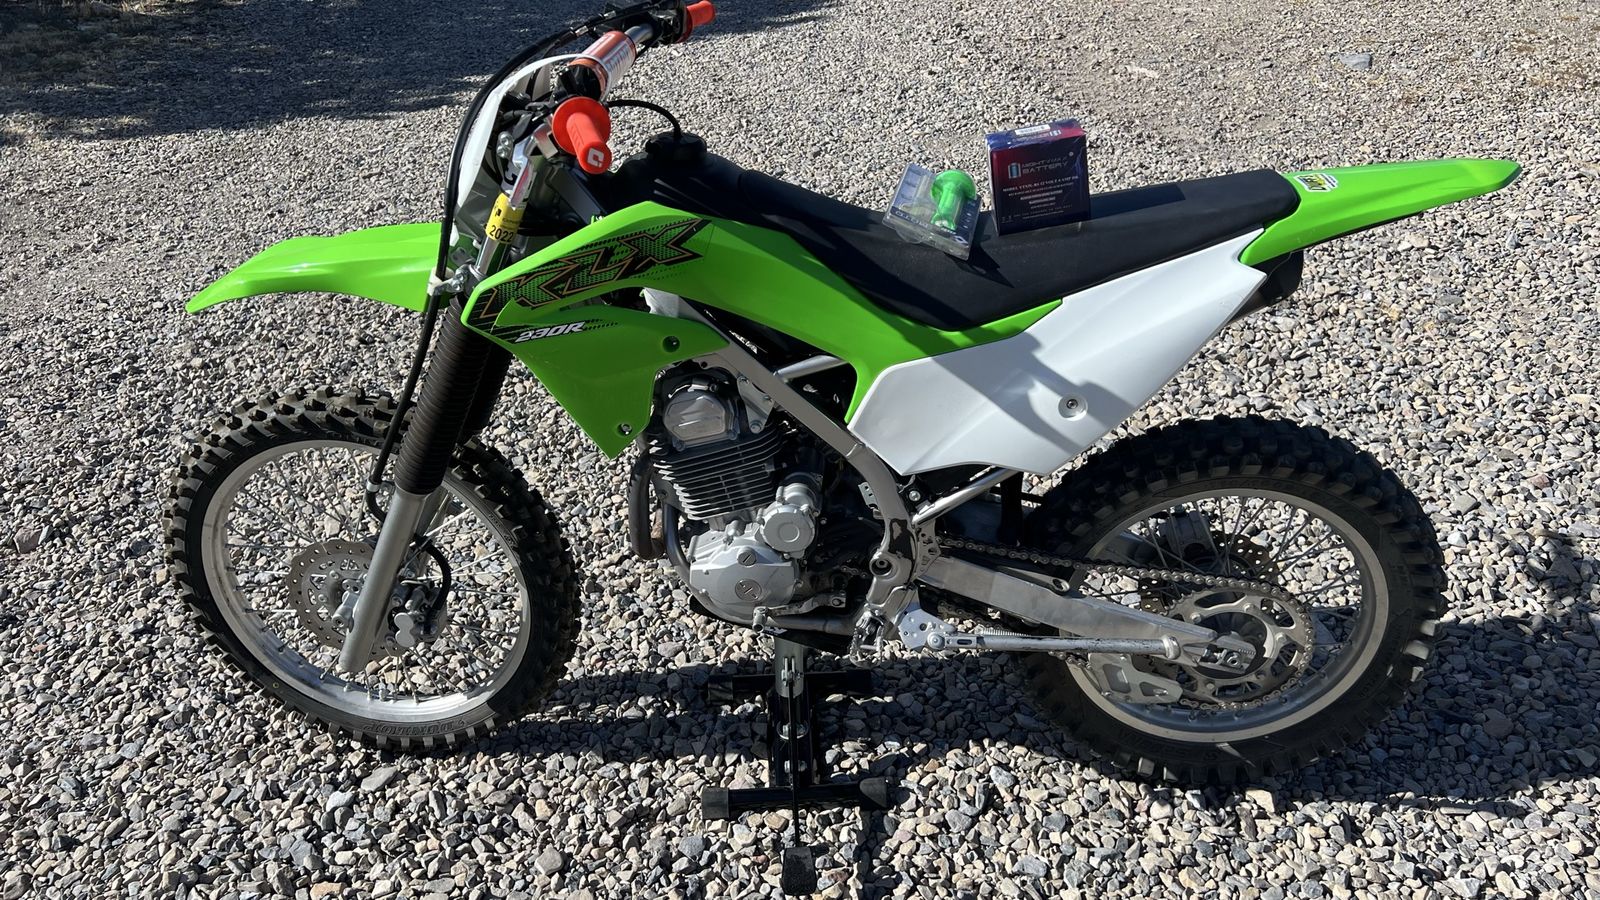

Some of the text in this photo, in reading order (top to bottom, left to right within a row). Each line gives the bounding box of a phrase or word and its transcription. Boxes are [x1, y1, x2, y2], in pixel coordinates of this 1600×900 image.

[1022, 162, 1068, 174] BATTERY
[489, 225, 514, 243] 2022
[479, 217, 705, 319] KLX
[514, 321, 587, 343] 230R
